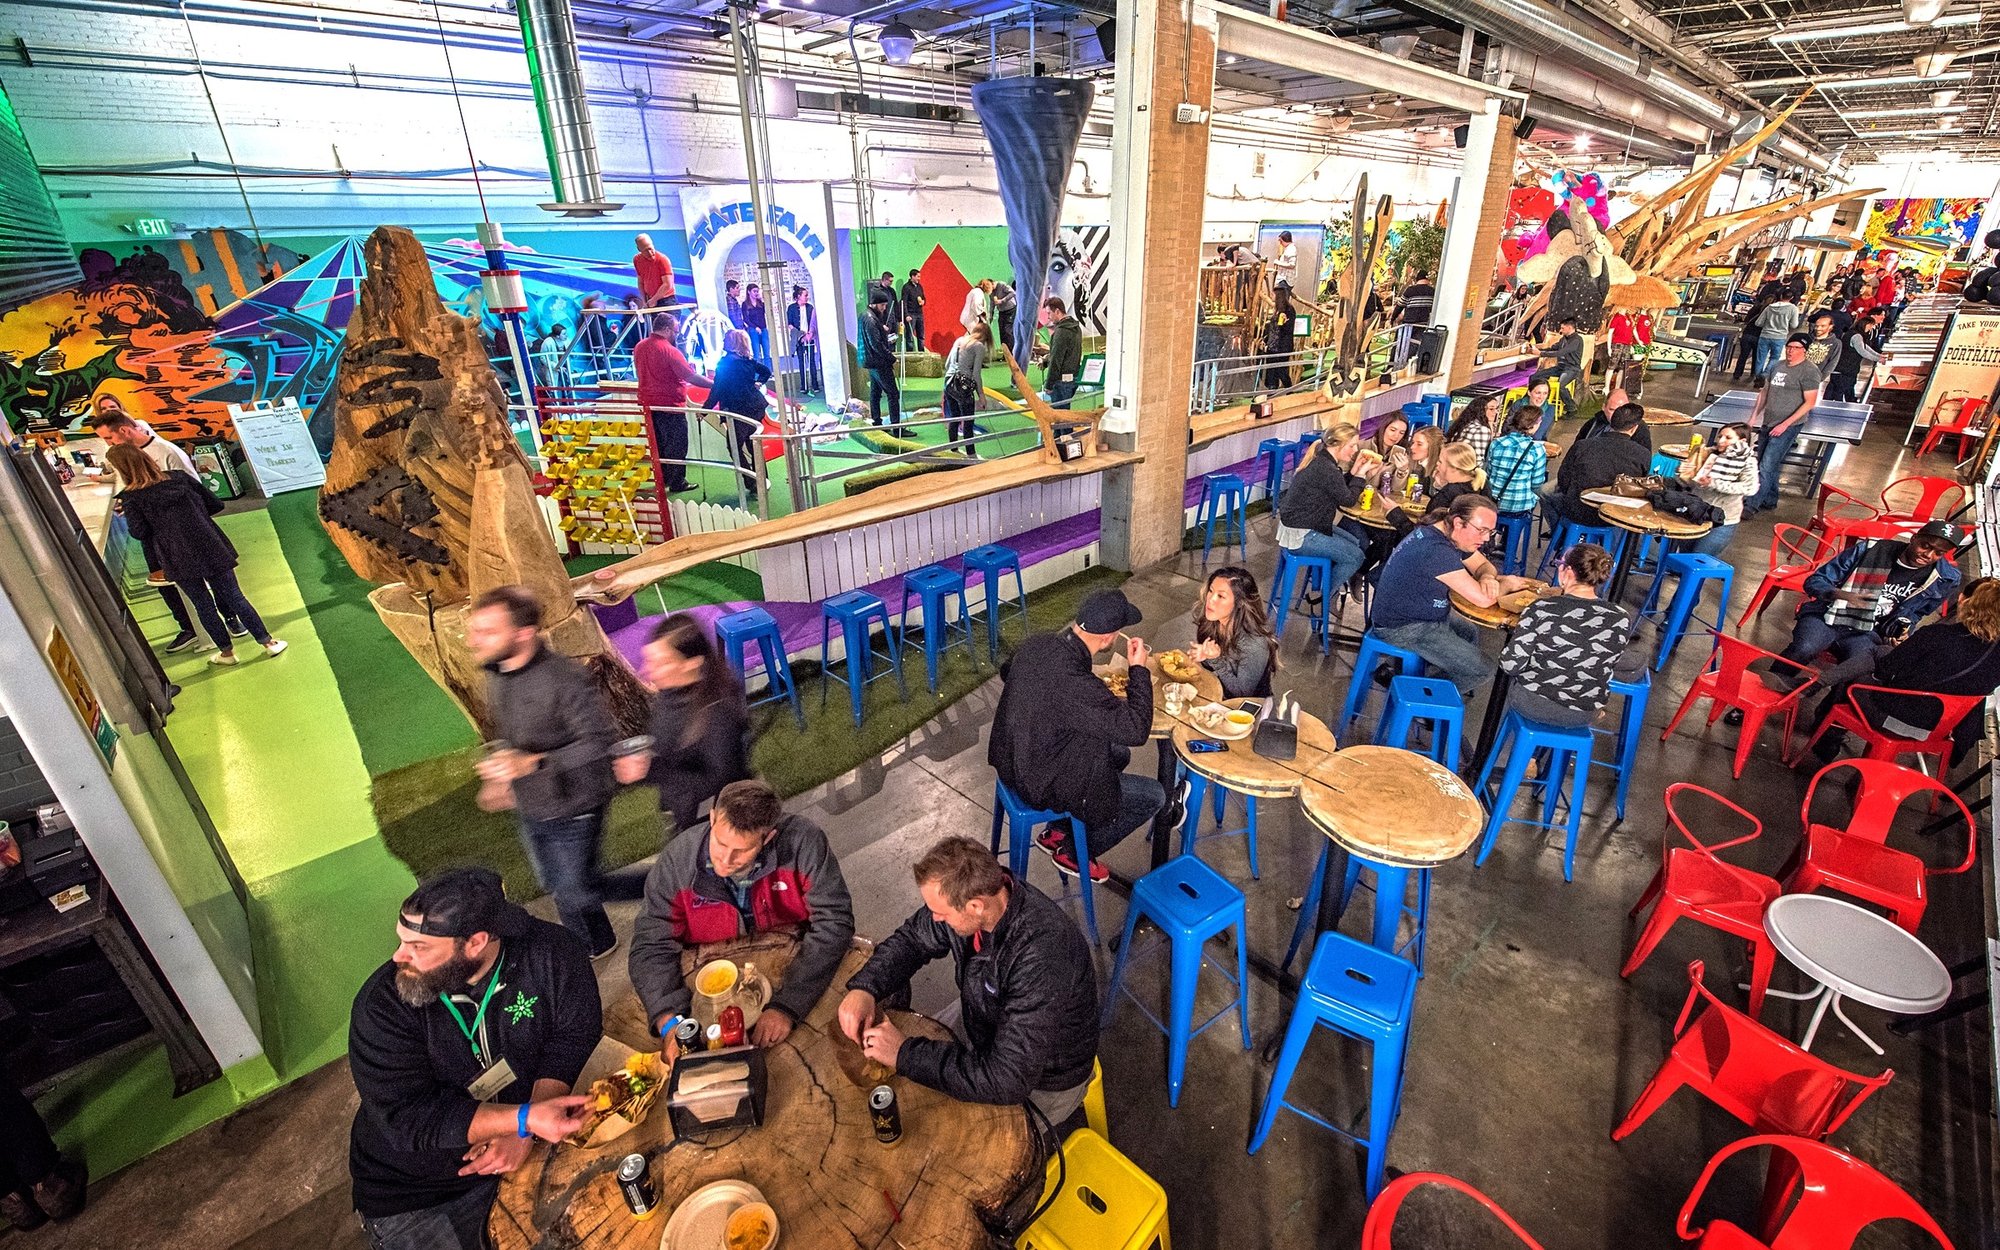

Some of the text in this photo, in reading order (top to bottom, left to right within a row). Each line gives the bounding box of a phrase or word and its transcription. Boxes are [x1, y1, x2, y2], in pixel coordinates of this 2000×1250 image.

[140, 219, 168, 235] EXIT
[690, 202, 825, 261] STATE FAIR
[1957, 320, 1999, 330] TAKE YOUR
[1944, 347, 2000, 362] PORTRAIT
